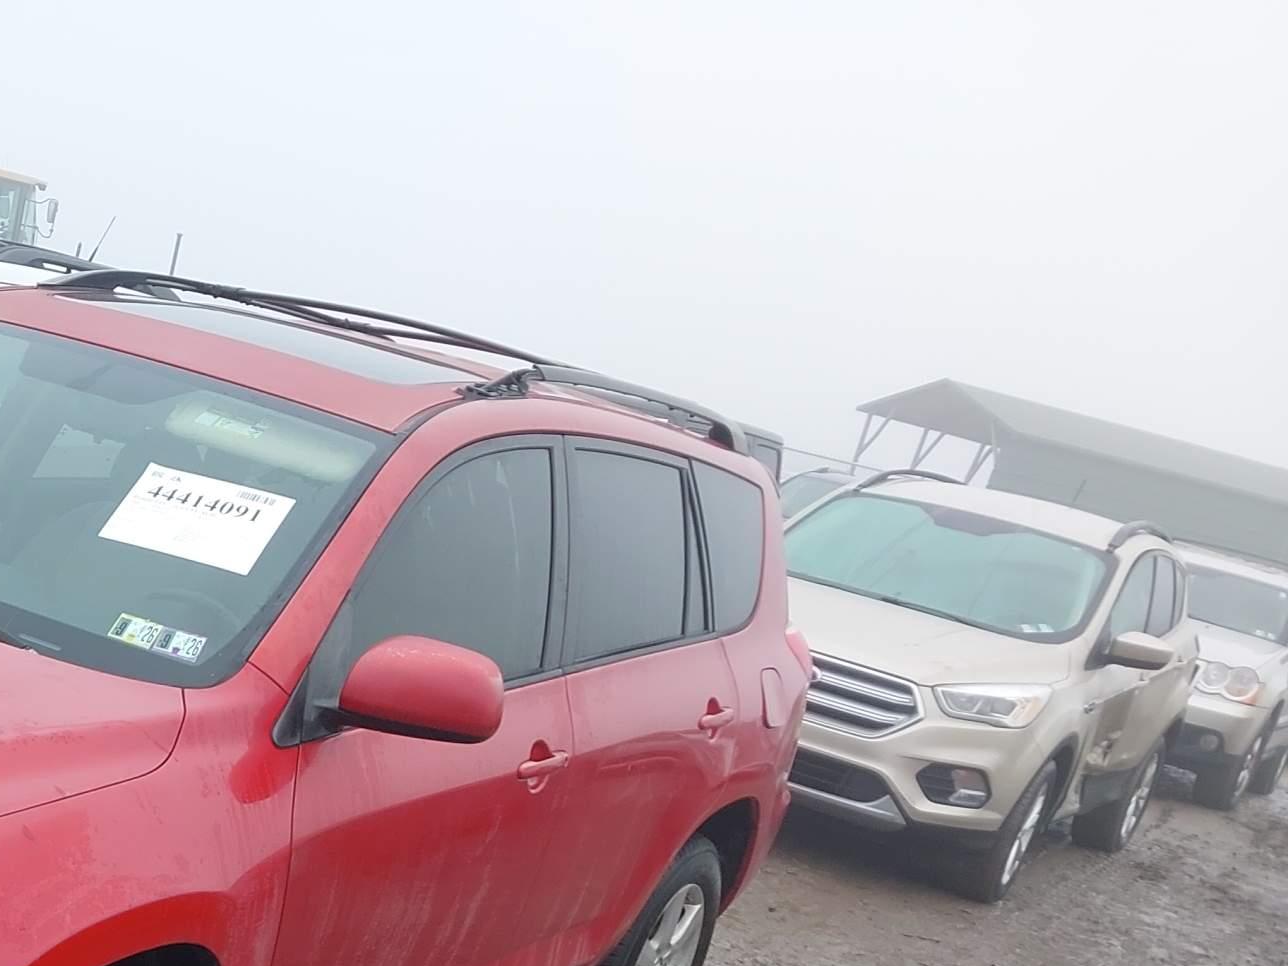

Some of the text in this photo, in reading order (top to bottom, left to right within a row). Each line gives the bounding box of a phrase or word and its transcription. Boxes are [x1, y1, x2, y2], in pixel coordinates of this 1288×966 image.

[147, 485, 261, 522] 44414091
[141, 626, 159, 644] 26
[186, 638, 203, 656] 26
